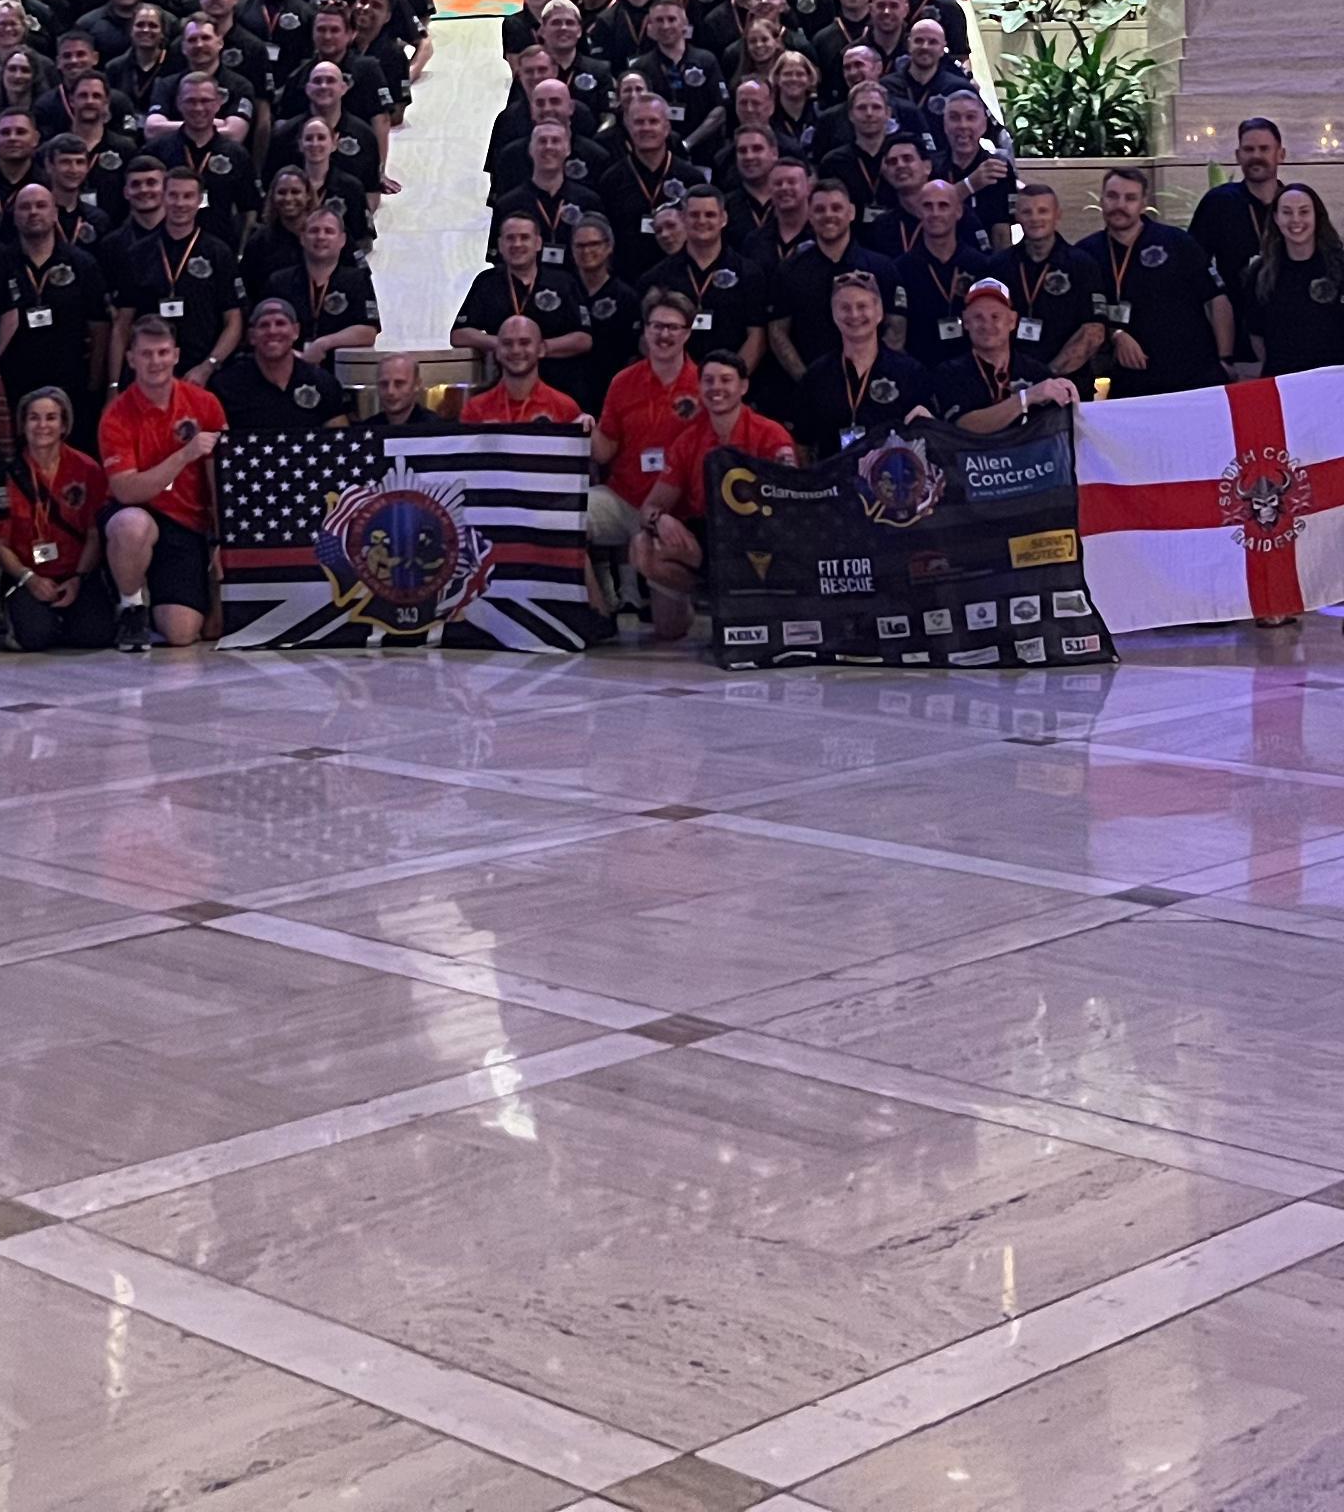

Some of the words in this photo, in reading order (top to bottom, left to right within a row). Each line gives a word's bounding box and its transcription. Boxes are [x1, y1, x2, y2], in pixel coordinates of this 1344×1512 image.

[965, 457, 1012, 472] Allen
[968, 460, 1055, 488] Concrete
[1219, 449, 1256, 506] SOUTH
[1263, 447, 1312, 491] COAST
[760, 484, 839, 499] Claremont
[1231, 519, 1306, 552] RAIDERS
[818, 559, 839, 576] FIT
[843, 558, 871, 576] FOR
[819, 576, 876, 595] RESCUE
[396, 606, 420, 624] 343
